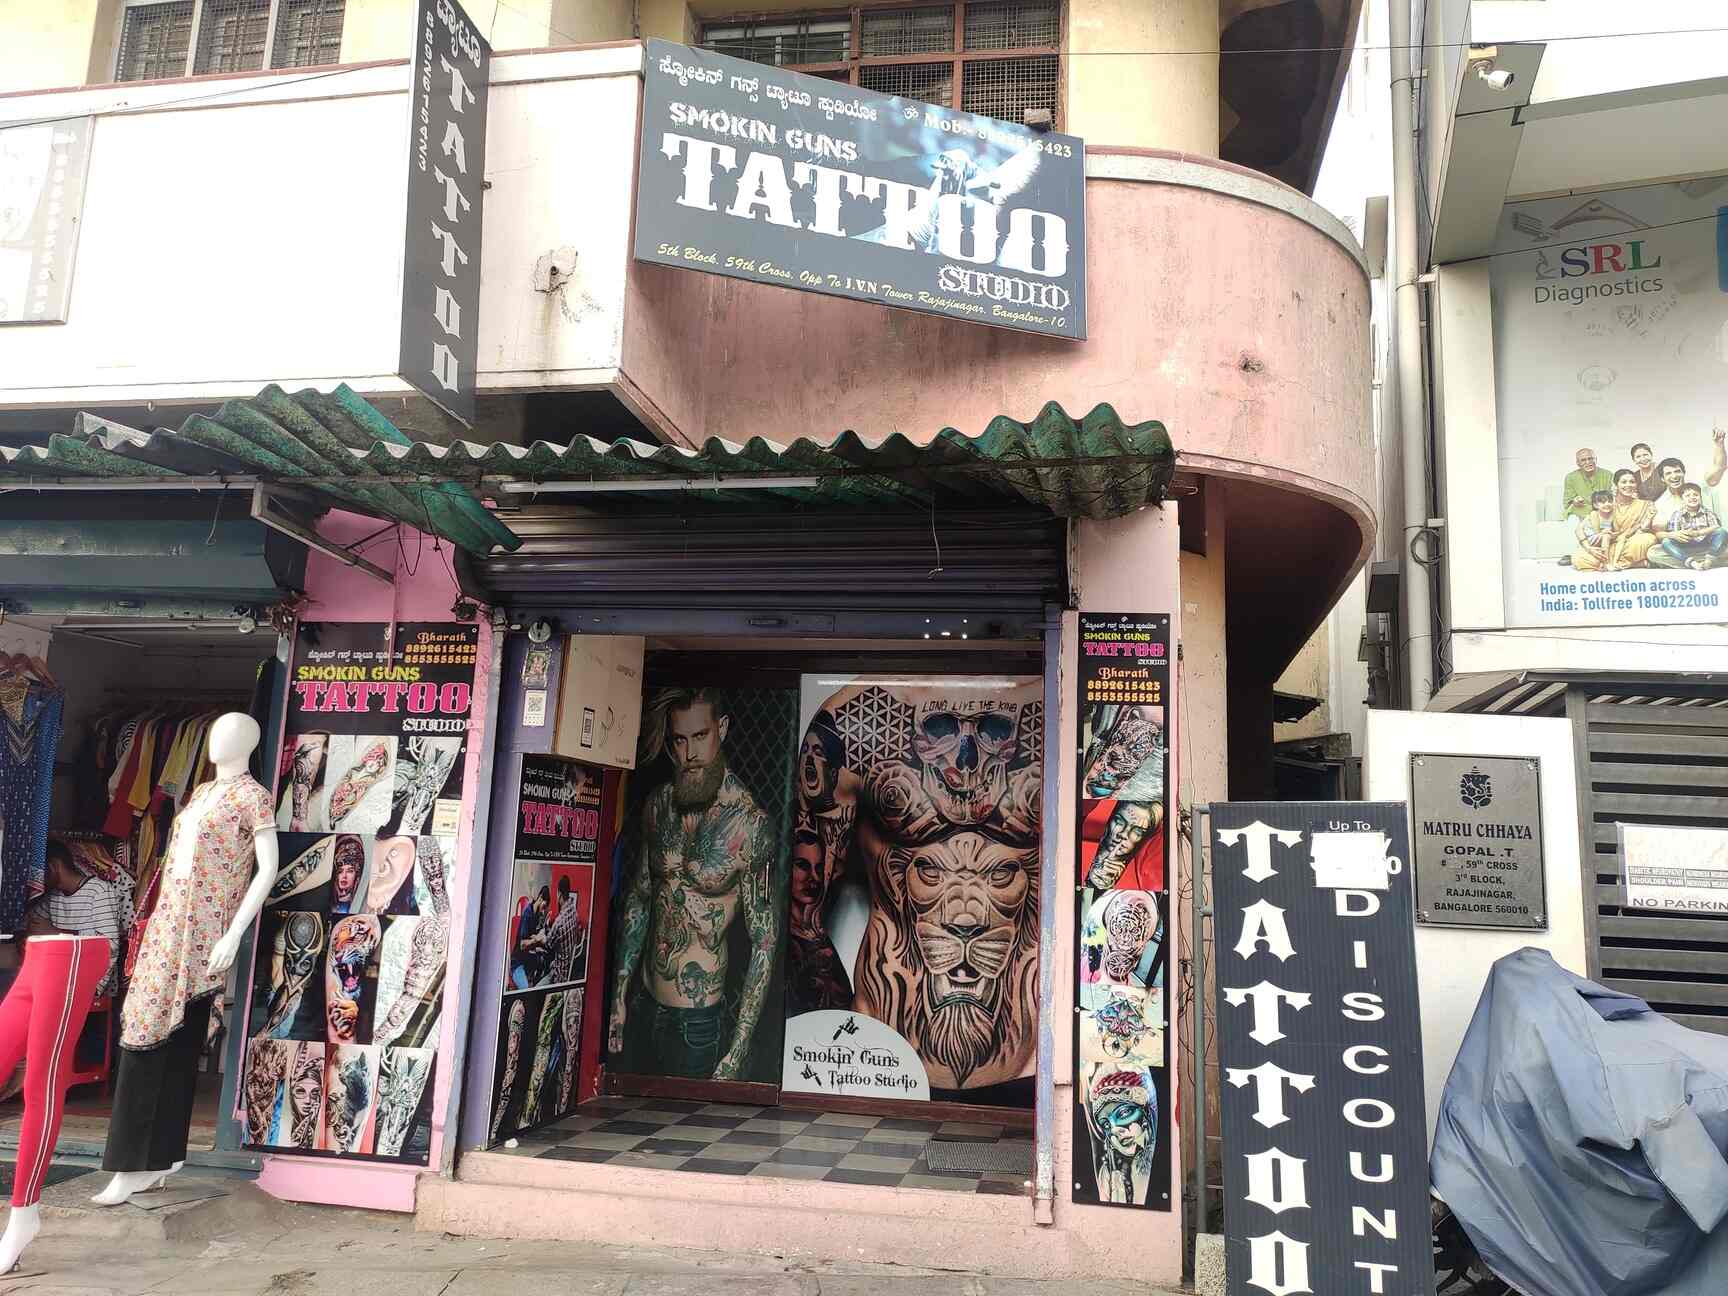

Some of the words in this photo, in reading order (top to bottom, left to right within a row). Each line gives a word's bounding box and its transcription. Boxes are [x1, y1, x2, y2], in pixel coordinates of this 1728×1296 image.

[669, 102, 778, 145] SMOKIN
[785, 128, 859, 162] GUNS
[659, 132, 1071, 278] TATTOO
[430, 53, 476, 394] TATTOO
[1560, 240, 1661, 278] SRL
[657, 243, 680, 258] 5th
[799, 269, 823, 286] Opp
[827, 274, 842, 289] To
[881, 284, 914, 303] Tower
[937, 263, 1071, 312] STUDIO
[1535, 277, 1664, 306] Diagnostics
[1540, 582, 1577, 596] Home
[1580, 579, 1647, 594] collection
[1650, 580, 1696, 592] across
[1541, 597, 1578, 612] India:
[1582, 597, 1633, 610] Tollfree
[1637, 593, 1719, 609] 1800222000
[417, 631, 467, 644] Bharath
[1084, 632, 1121, 640] SMOKIN
[1123, 632, 1151, 641] GUNS
[1083, 642, 1165, 656] TATTOO
[298, 664, 367, 681] SMOKIN
[371, 666, 421, 681] GUNS
[1098, 667, 1149, 679] Bharath
[296, 681, 472, 713] TATTOO
[922, 700, 948, 713] LONG
[952, 700, 976, 712] LIVE
[979, 699, 995, 711] THE
[402, 718, 466, 732] STUDIO
[523, 783, 550, 799] SMOKIN
[522, 800, 599, 840] TATTOO
[1329, 820, 1350, 833] Up
[1353, 820, 1371, 831] To
[1424, 821, 1472, 838] MATRU
[1476, 823, 1532, 840] CHHAYA
[1444, 845, 1495, 857] GOPAL
[1486, 861, 1519, 871] CROSS
[1434, 902, 1492, 913] BANGALORE
[1495, 903, 1529, 914] 560010
[1632, 898, 1659, 908] NO
[860, 1050, 900, 1068] Guns
[1216, 820, 1317, 1296] TATTOO
[828, 1070, 871, 1091] Tattoo
[874, 1072, 917, 1092] Studio
[1334, 889, 1398, 1294] DISCOUNT
